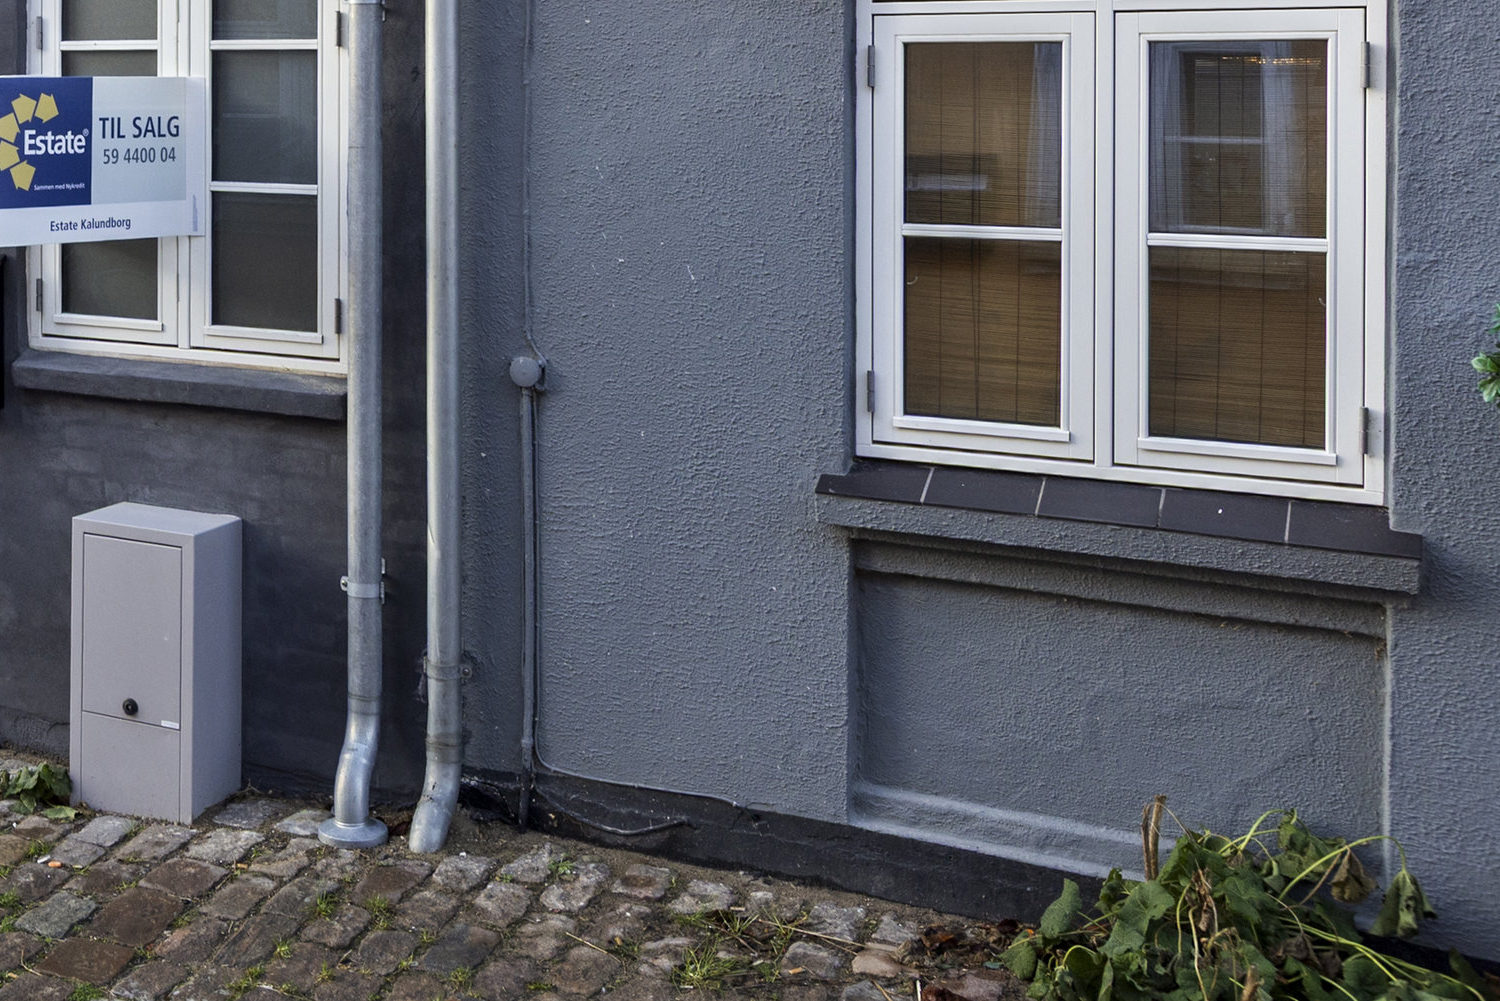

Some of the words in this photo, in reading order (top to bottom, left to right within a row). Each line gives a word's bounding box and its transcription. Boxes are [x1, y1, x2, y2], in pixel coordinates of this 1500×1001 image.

[99, 117, 126, 139] TIL
[132, 116, 180, 138] SALG
[103, 148, 119, 165] 59
[123, 147, 156, 164] 4400
[160, 146, 176, 163] 04
[50, 220, 79, 232] Estate
[80, 217, 132, 231] Kalundborg
